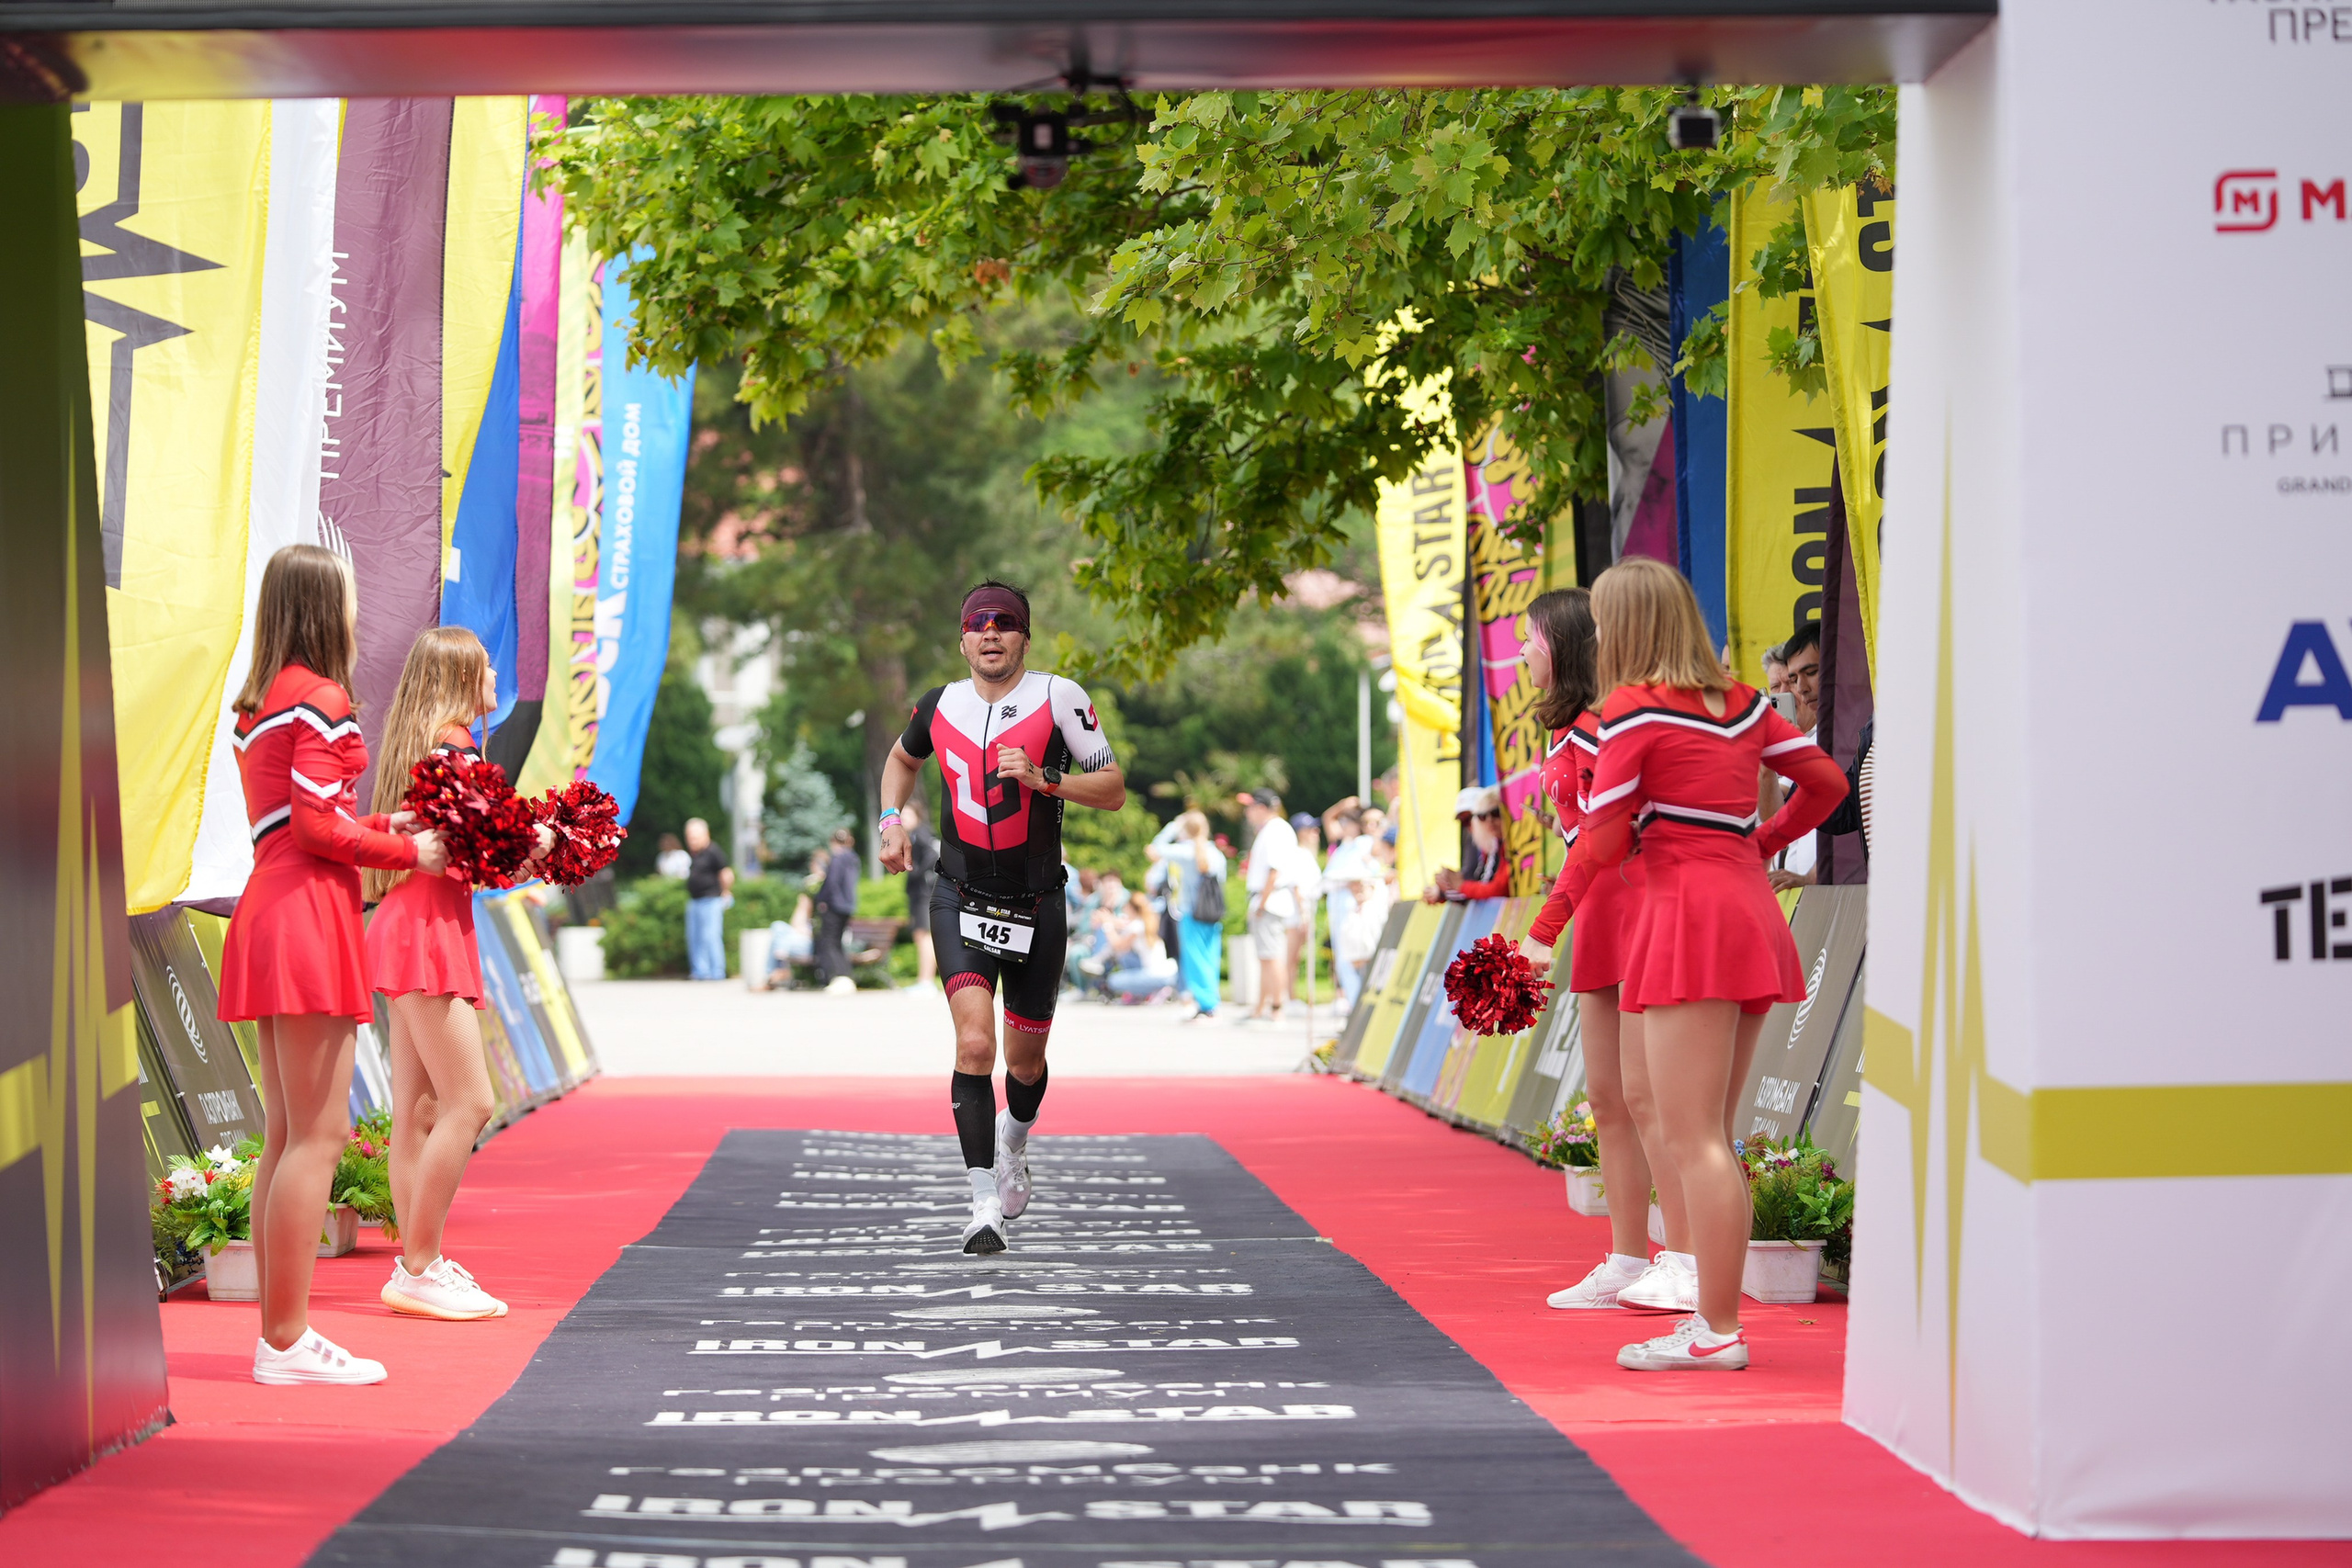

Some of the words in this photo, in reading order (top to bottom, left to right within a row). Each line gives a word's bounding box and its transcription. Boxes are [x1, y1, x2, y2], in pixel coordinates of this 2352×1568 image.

[621, 401, 643, 457] ДОМ
[610, 461, 640, 590] СТРАХОВОЙ
[1413, 464, 1454, 581] STAR
[977, 921, 1012, 945] 145
[983, 944, 1002, 956] GALSAN
[721, 1285, 926, 1295] IRON
[1034, 1283, 1254, 1293] STAR
[694, 1339, 926, 1351] IRON
[1050, 1337, 1301, 1348] STAR
[652, 1410, 922, 1422] IRON
[1066, 1404, 1358, 1418] STAR
[588, 1494, 914, 1517] IRON
[1083, 1500, 1431, 1520] STAR
